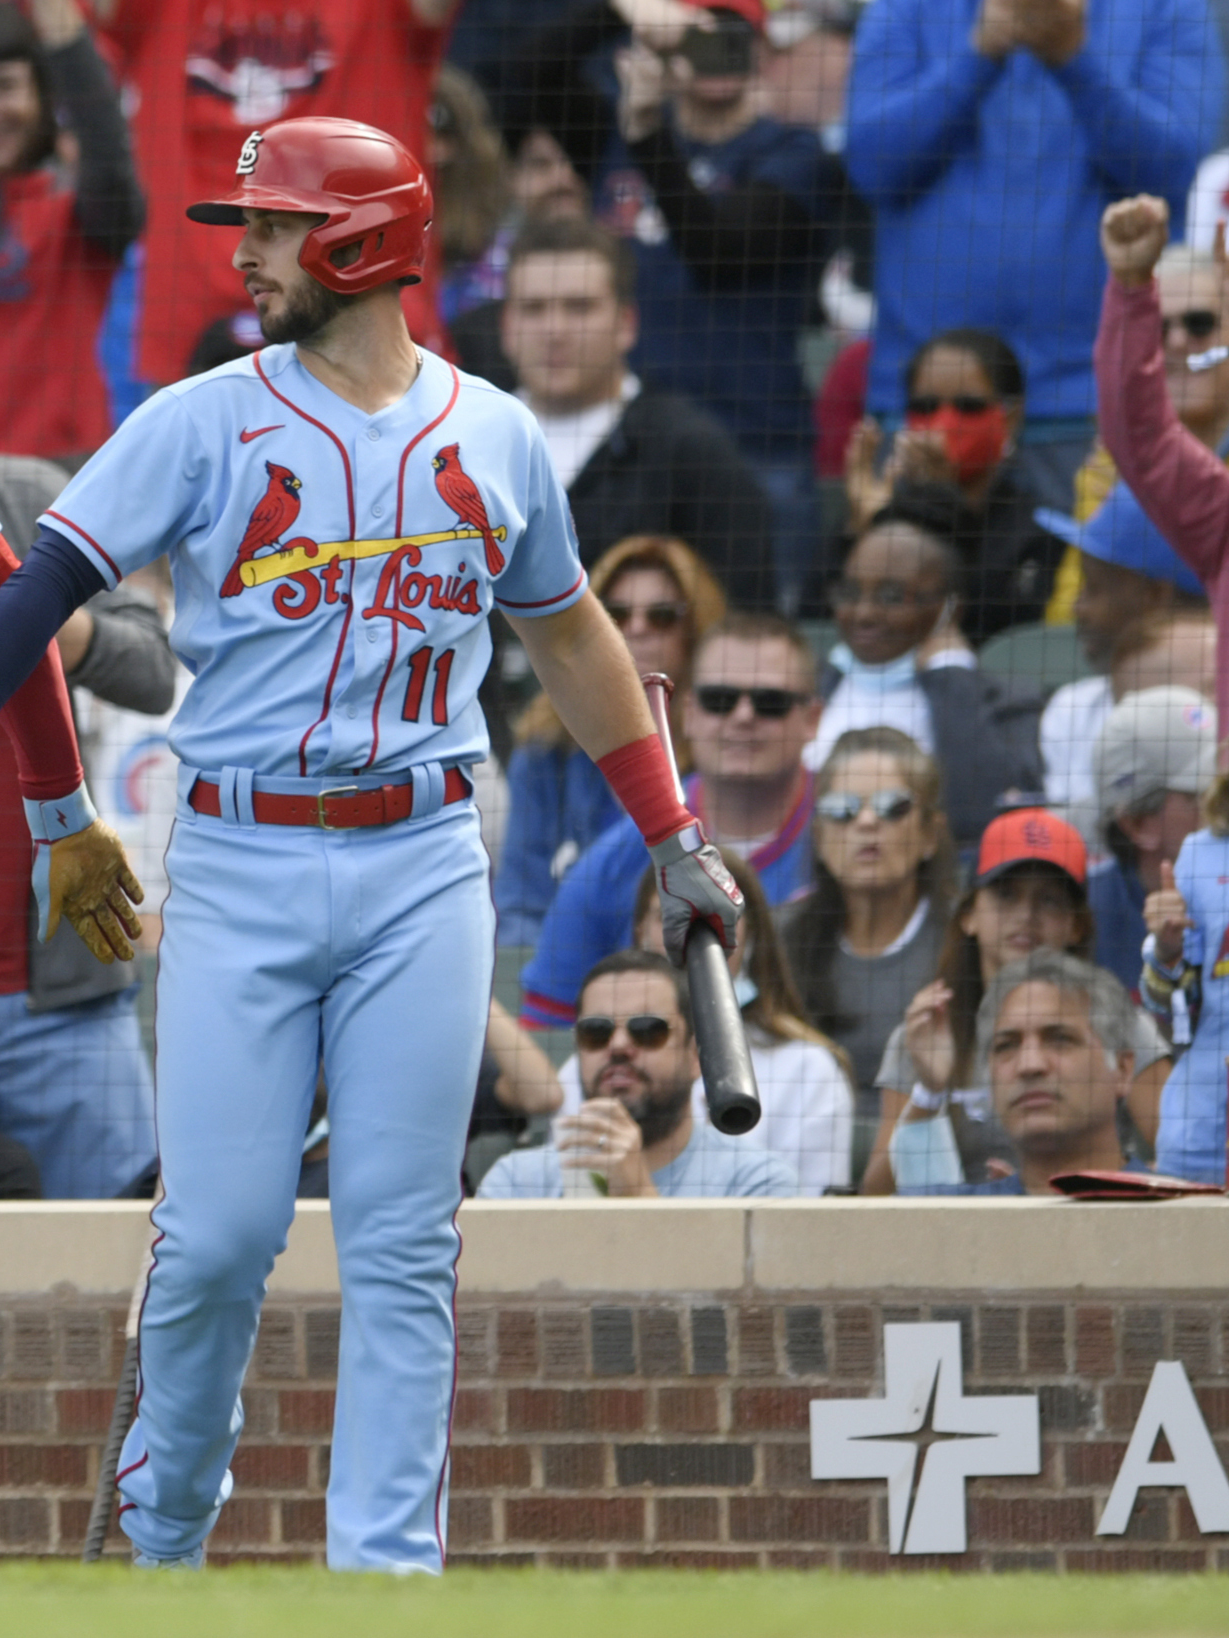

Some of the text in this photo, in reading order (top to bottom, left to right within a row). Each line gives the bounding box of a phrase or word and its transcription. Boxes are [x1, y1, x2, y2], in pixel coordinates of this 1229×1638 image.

[273, 536, 482, 633] St. Louis
[401, 645, 456, 726] 11
[1095, 1360, 1229, 1536] A
